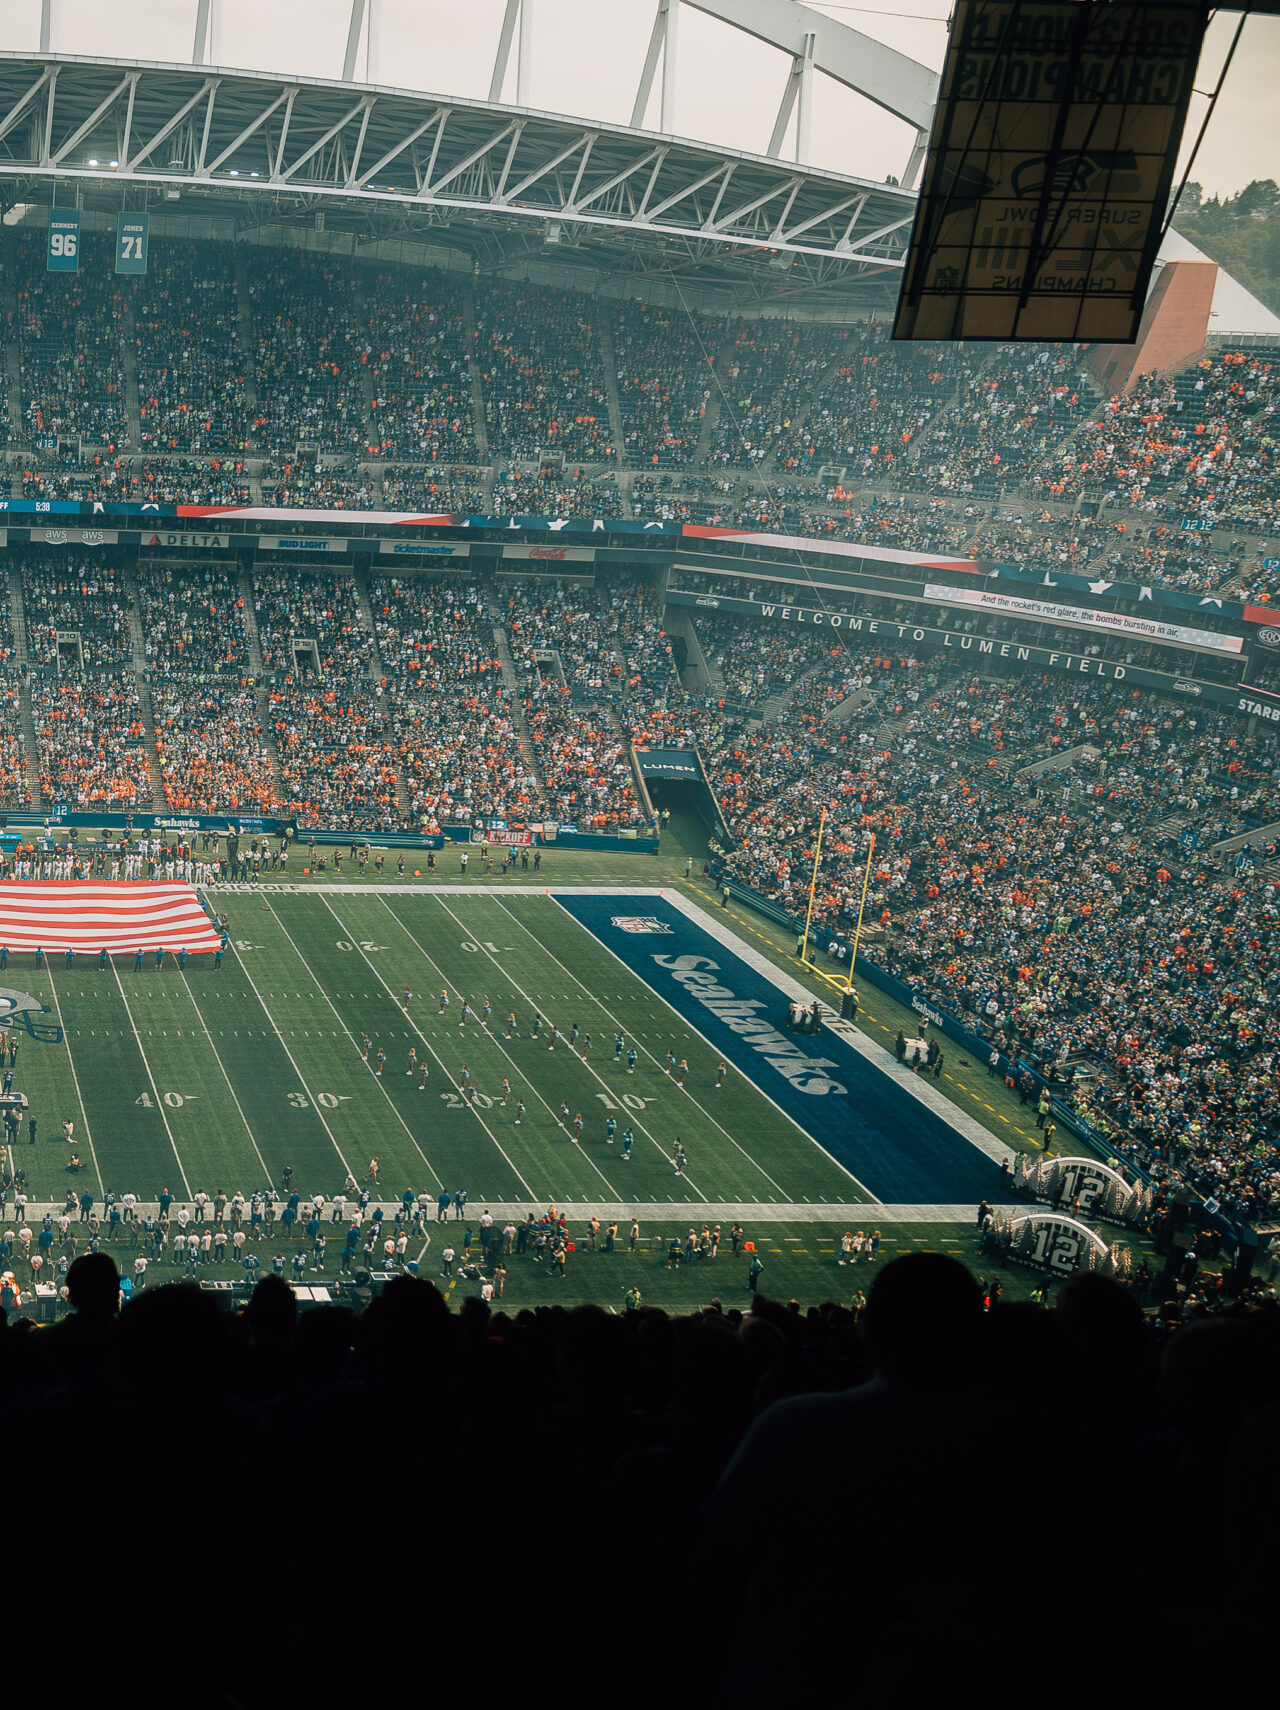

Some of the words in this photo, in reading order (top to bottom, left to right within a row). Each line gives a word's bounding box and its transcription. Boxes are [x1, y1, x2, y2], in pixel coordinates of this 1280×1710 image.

[51, 234, 77, 257] 96
[121, 236, 143, 259] 71
[44, 439, 54, 448] 12
[1184, 519, 1198, 530] 12
[1200, 519, 1213, 530] 12
[167, 535, 221, 547] DELTA
[981, 594, 995, 604] And
[997, 597, 1009, 607] the
[1010, 600, 1041, 612] rocket's
[1042, 606, 1056, 615] red
[1081, 611, 1094, 621] the
[1096, 614, 1122, 626] bombs
[1124, 618, 1155, 634] bursting
[1157, 625, 1165, 634] in
[761, 605, 878, 634] WELCOME
[897, 626, 925, 641] TO
[944, 633, 1030, 661] LUMEN
[1049, 653, 1126, 681] FIELD
[643, 763, 695, 773] LUMEN
[56, 805, 68, 815] 12
[491, 820, 505, 829] 12
[1183, 834, 1194, 845] 12
[911, 995, 944, 1027] Seahawks
[650, 954, 848, 1095] Seahawks
[135, 1091, 184, 1108] 40
[286, 1091, 339, 1109] 30
[440, 1093, 494, 1109] 20
[595, 1093, 646, 1110] 10
[1060, 1170, 1105, 1208] 12
[1031, 1228, 1080, 1272] 12
